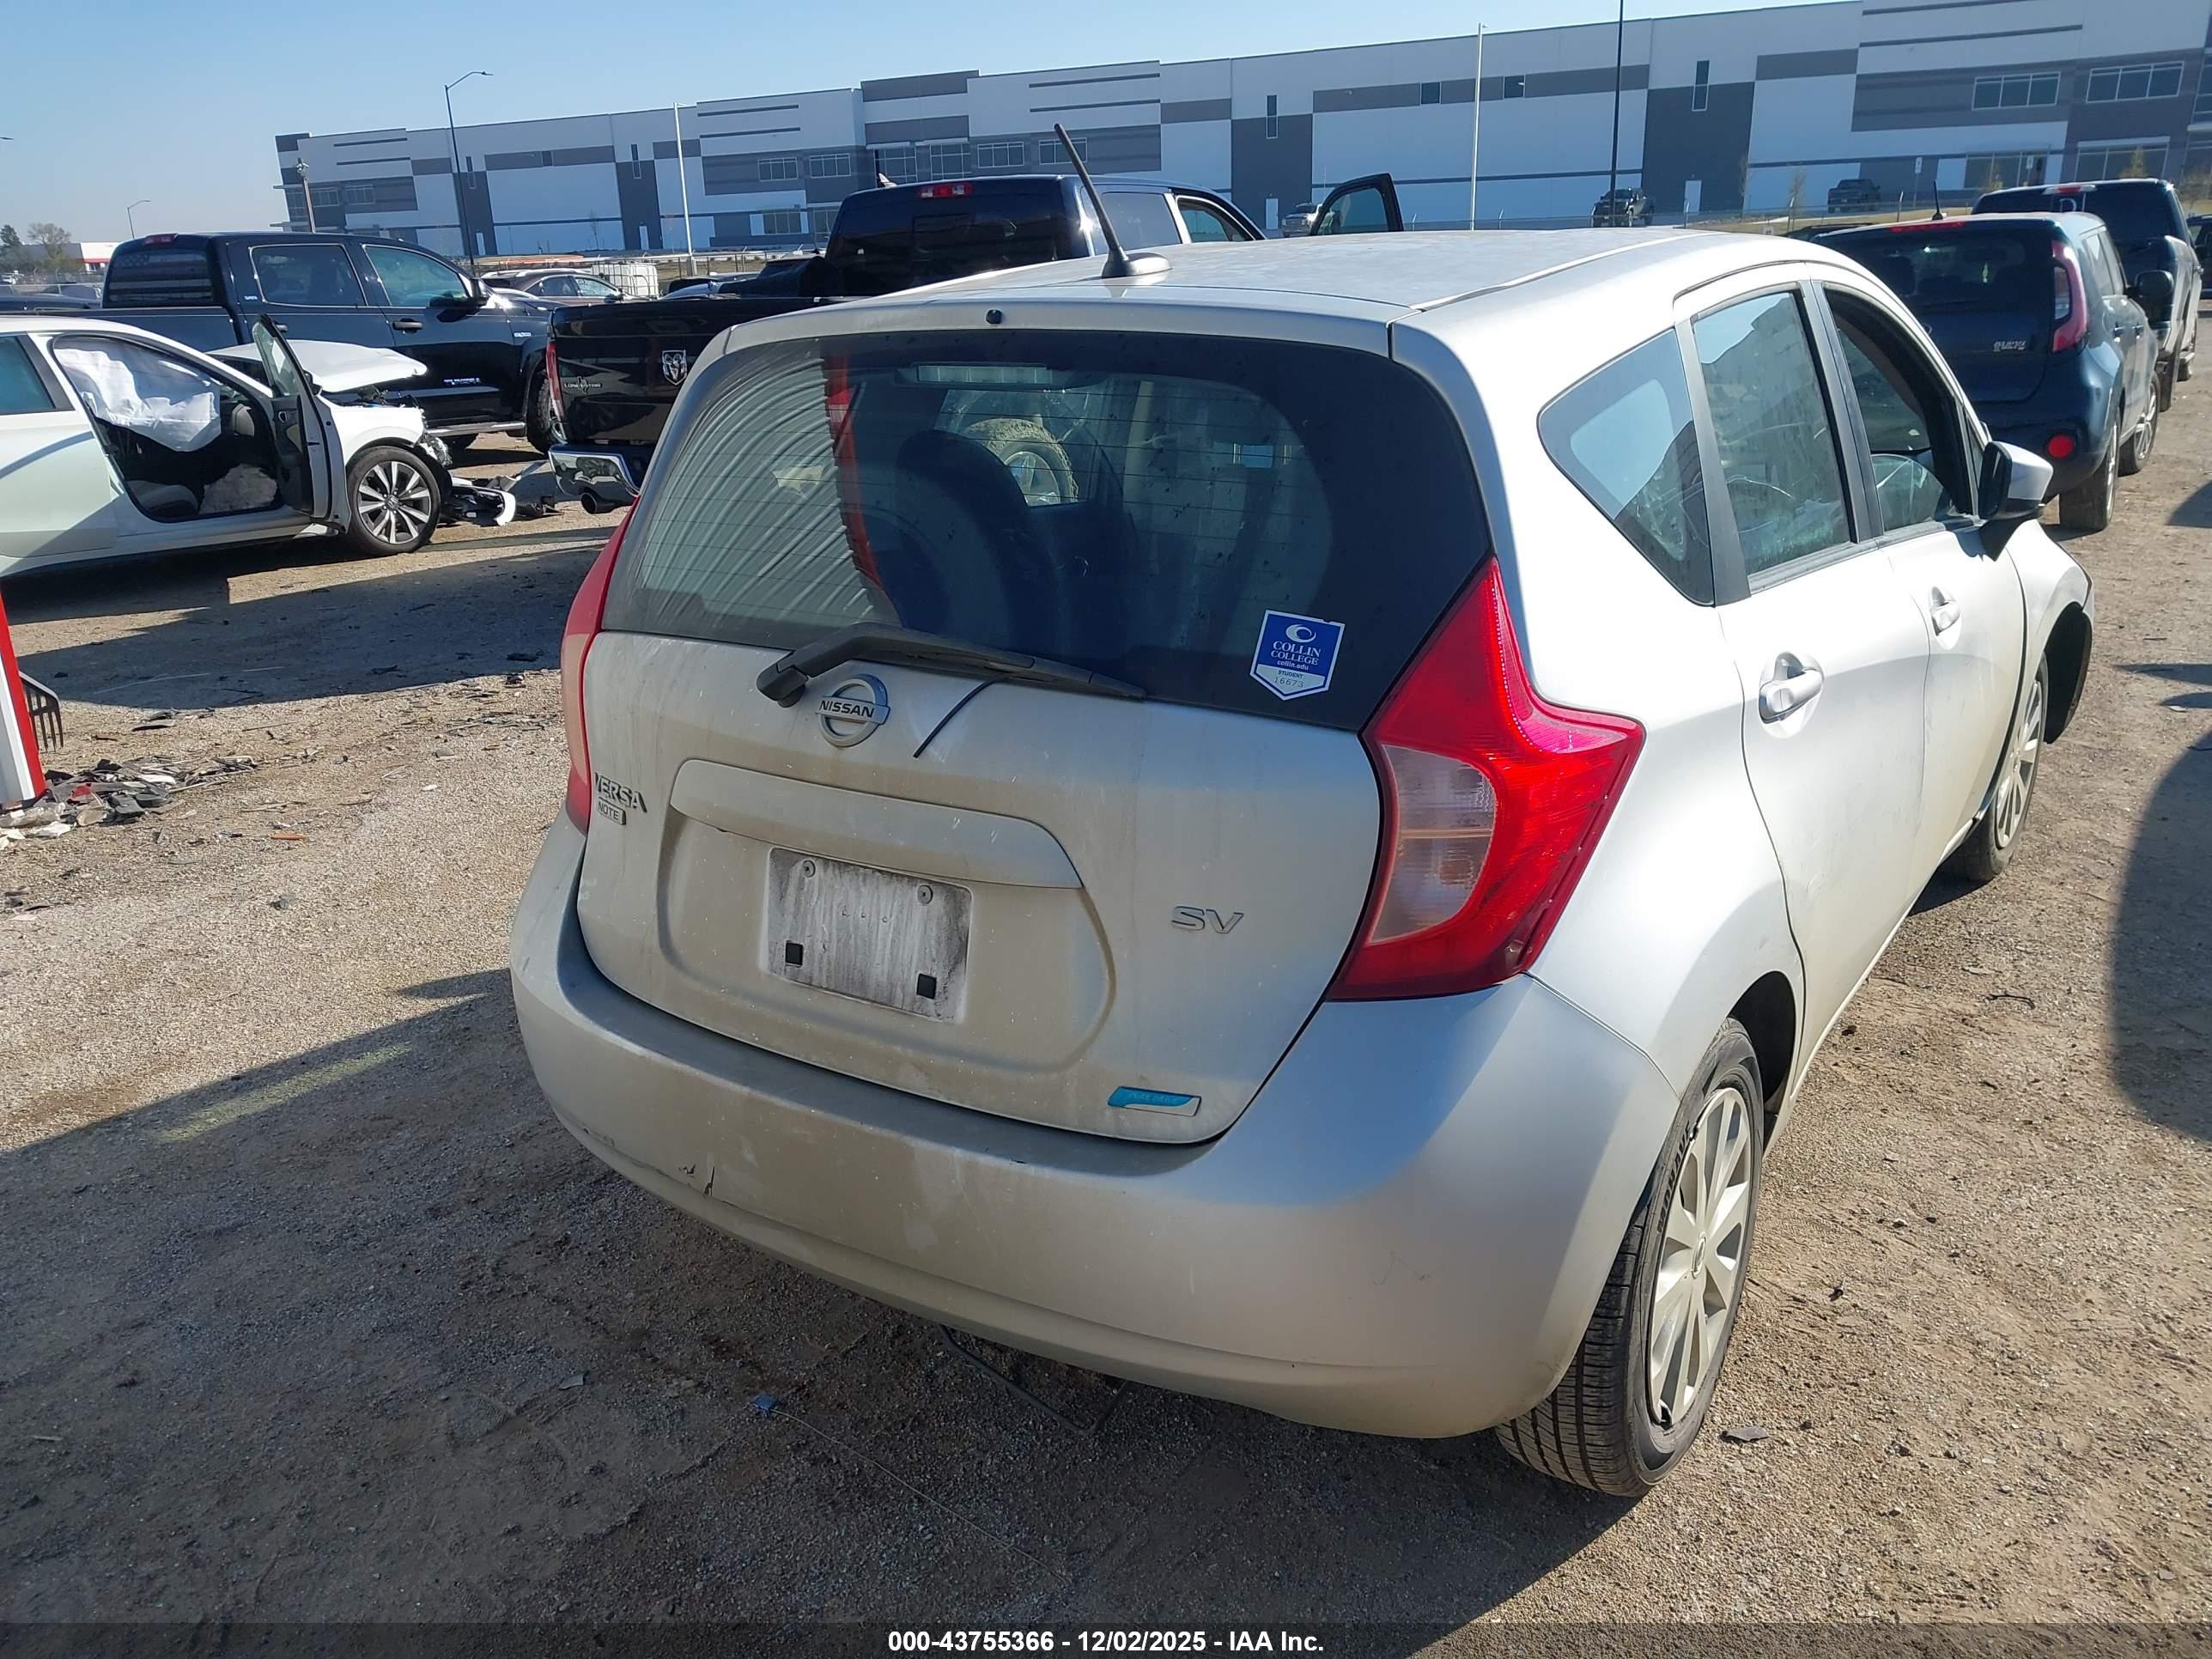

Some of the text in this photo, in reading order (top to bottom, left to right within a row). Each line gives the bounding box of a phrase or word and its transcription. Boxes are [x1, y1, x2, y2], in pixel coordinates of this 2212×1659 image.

[1270, 650, 1320, 665] COLLEGE
[1273, 641, 1322, 658] COLLIN
[1277, 659, 1310, 671] collin.edu
[1273, 676, 1304, 688] 16673
[1278, 670, 1304, 679] STUDENT
[818, 700, 874, 718] NISSAN
[594, 772, 647, 813] VERSA
[598, 801, 619, 821] NOTE
[1170, 904, 1244, 934] SV
